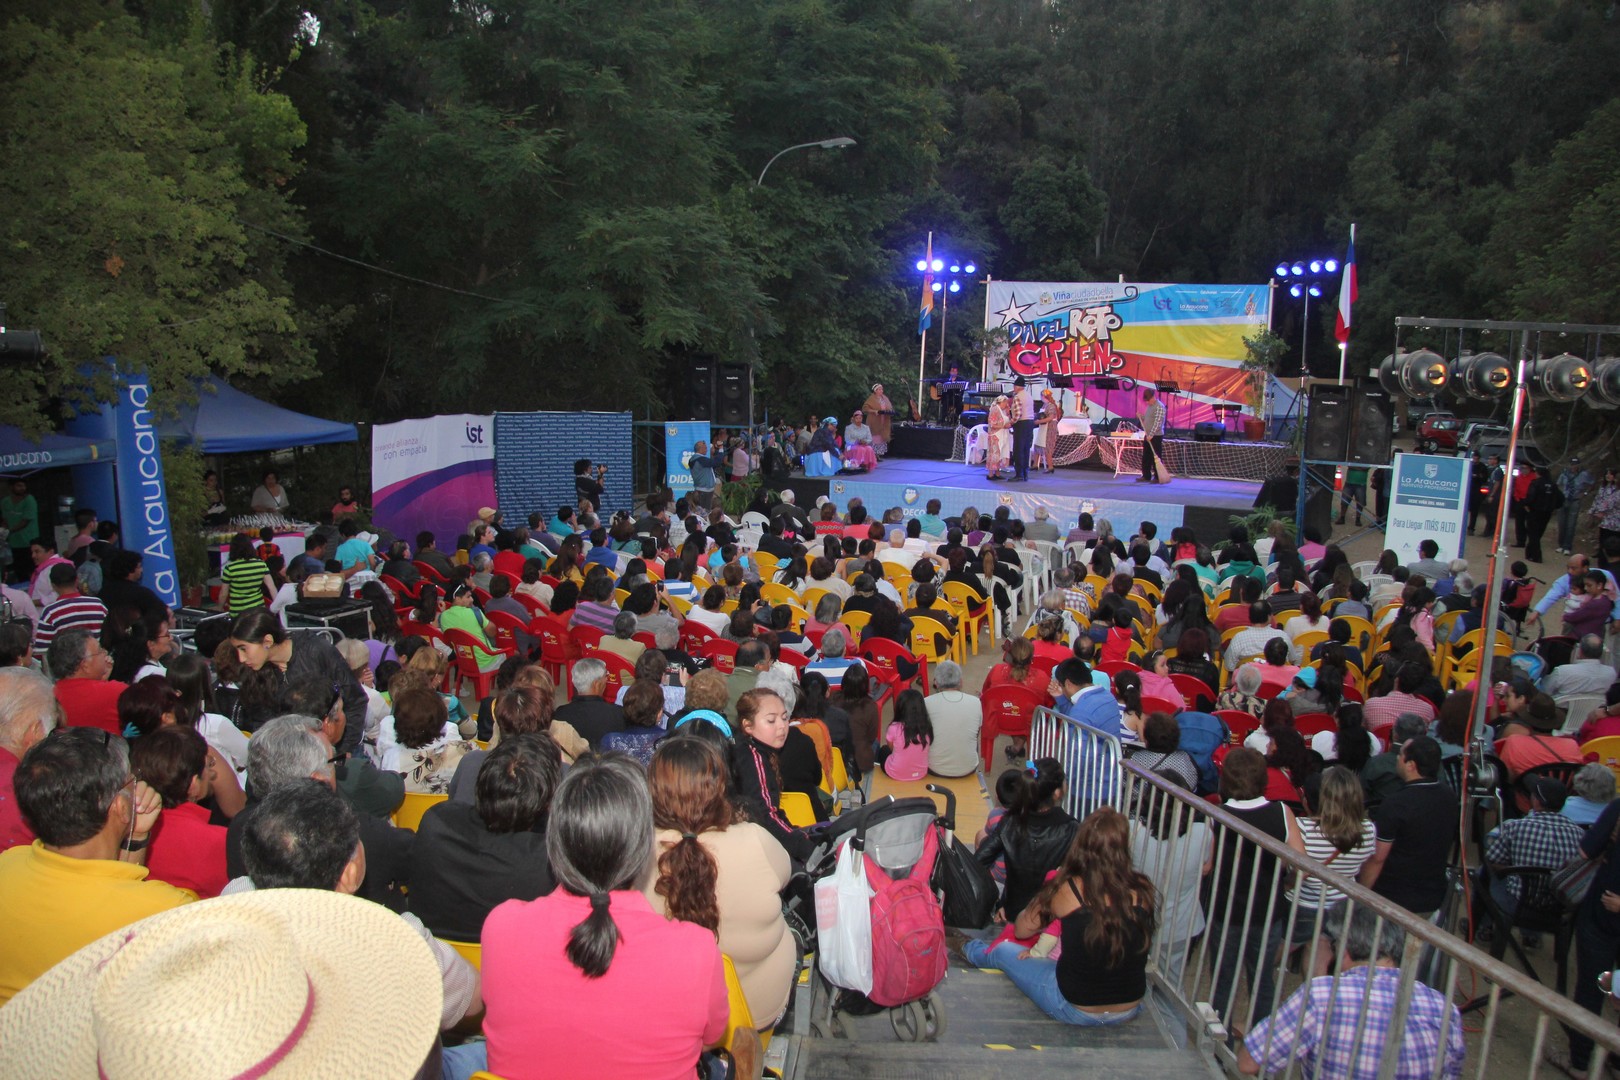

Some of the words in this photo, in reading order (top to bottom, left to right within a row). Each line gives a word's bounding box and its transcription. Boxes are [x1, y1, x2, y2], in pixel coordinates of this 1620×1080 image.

[1037, 320, 1067, 342] DEL
[465, 421, 484, 444] ist
[383, 450, 398, 460] con
[129, 384, 171, 560] Araucana
[669, 474, 694, 484] DIDE
[1414, 477, 1458, 488] Araucana
[902, 508, 926, 517] DECO
[1393, 518, 1406, 528] Para
[1406, 519, 1423, 531] Llegar
[1424, 518, 1440, 532] MÁS
[1440, 521, 1456, 533] ALTO
